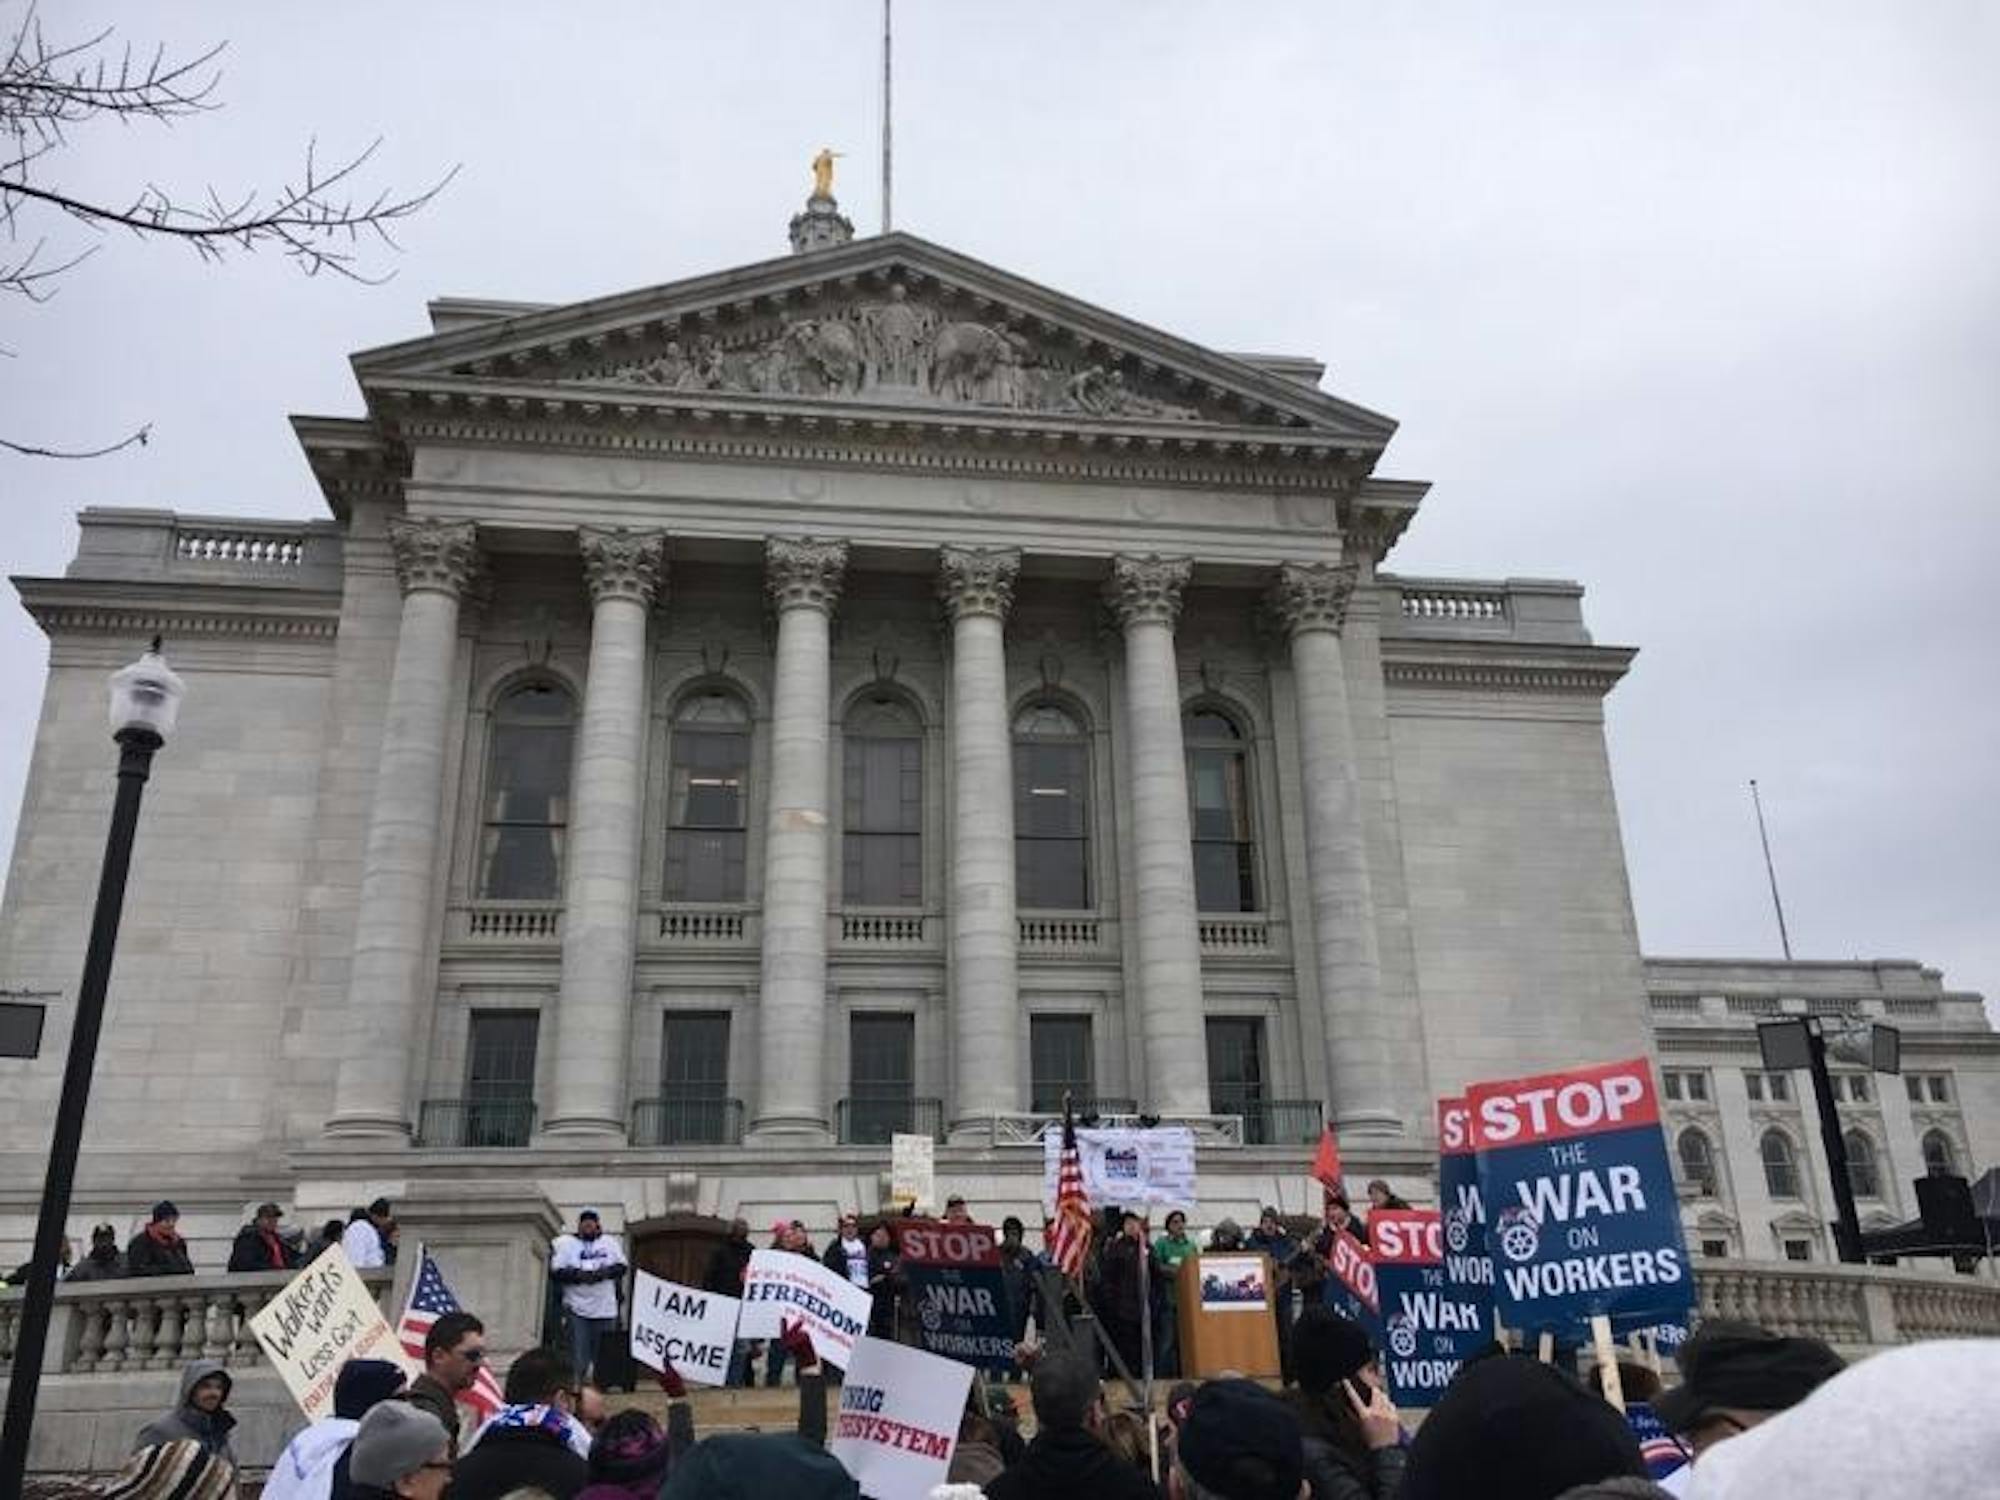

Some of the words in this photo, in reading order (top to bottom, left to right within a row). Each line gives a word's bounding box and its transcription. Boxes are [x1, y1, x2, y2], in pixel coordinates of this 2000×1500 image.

[1480, 1075, 1644, 1141] STOP
[1549, 1143, 1588, 1167] THE
[1516, 1165, 1647, 1224] WAR
[902, 1228, 992, 1262] STOP
[1375, 1219, 1443, 1258] STO
[1566, 1226, 1600, 1250] ON
[1446, 1256, 1495, 1286] WOR
[1503, 1248, 1682, 1301] WORKERS
[654, 1286, 661, 1309] I
[665, 1292, 708, 1320] AM
[925, 1284, 997, 1317] WAR
[635, 1324, 726, 1370] AFSCME
[1433, 1336, 1454, 1353] ON
[1391, 1360, 1459, 1389] WORK
